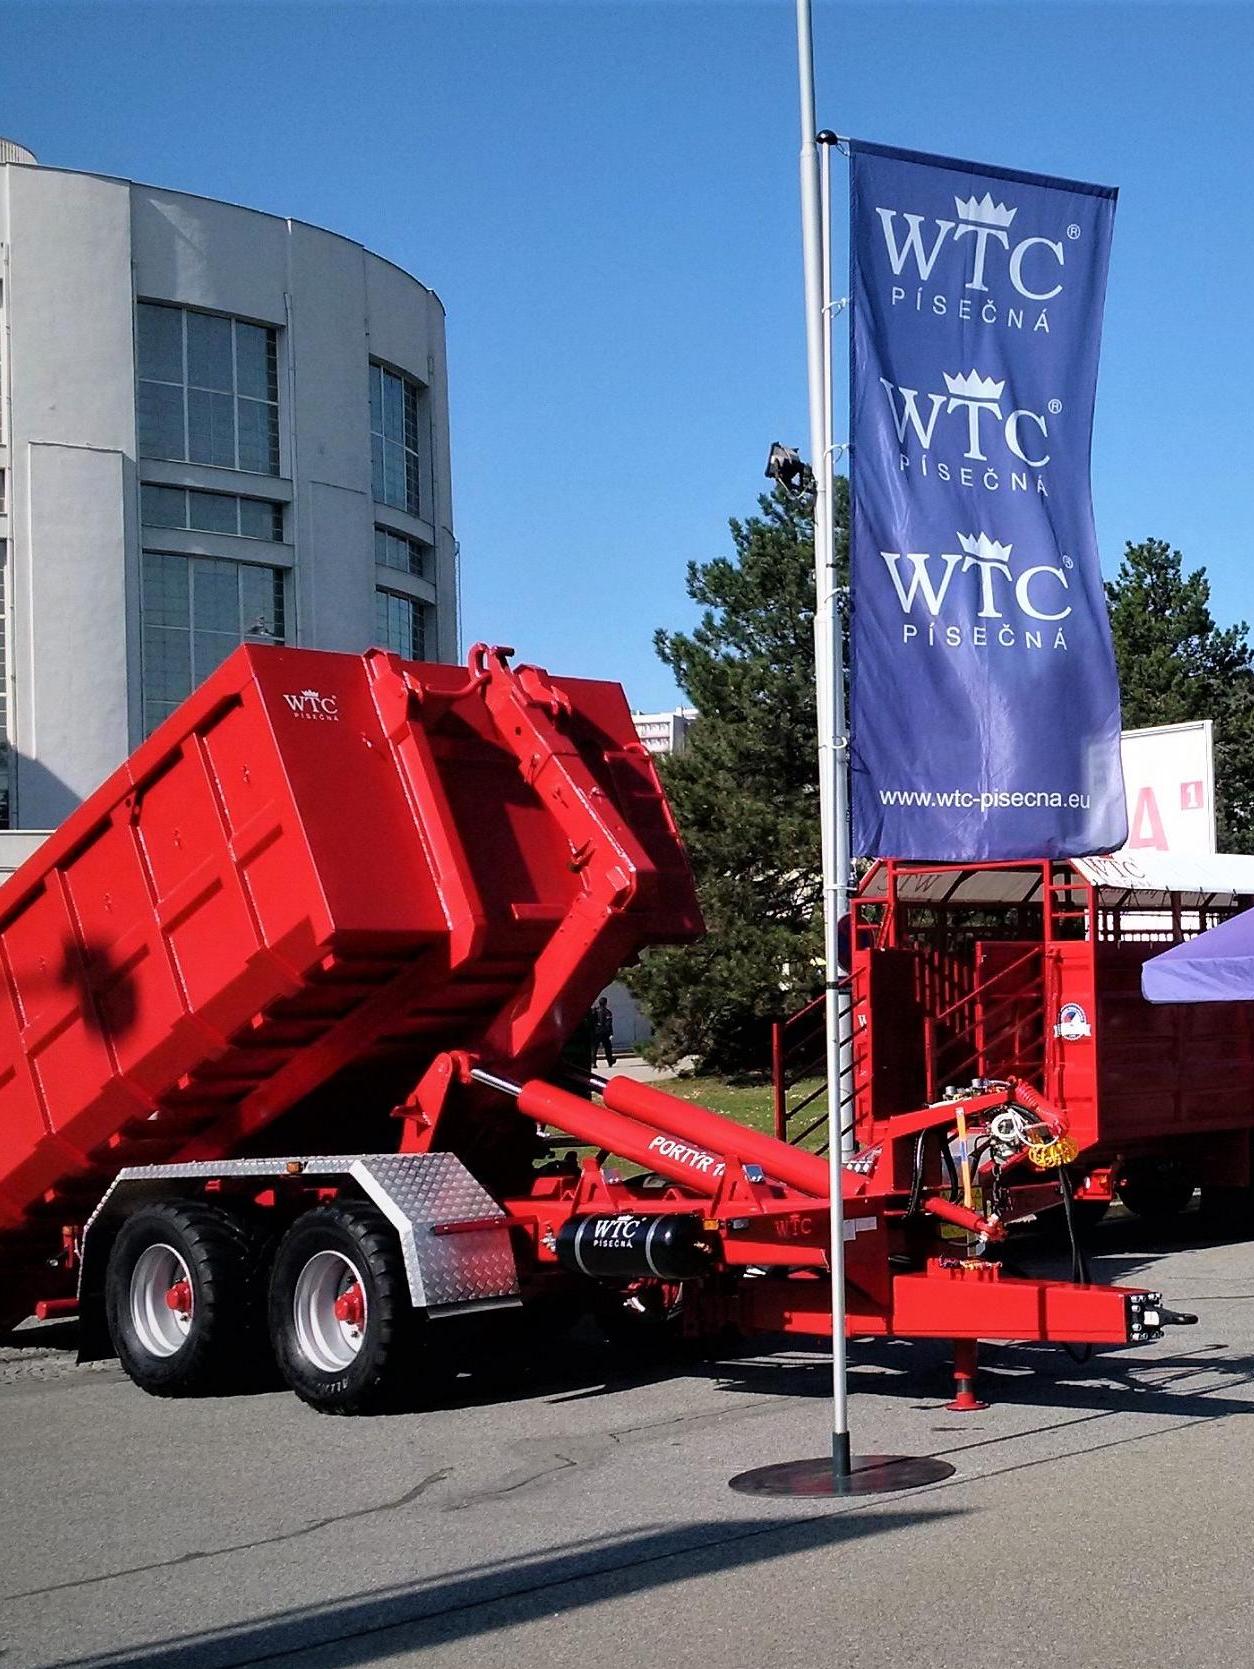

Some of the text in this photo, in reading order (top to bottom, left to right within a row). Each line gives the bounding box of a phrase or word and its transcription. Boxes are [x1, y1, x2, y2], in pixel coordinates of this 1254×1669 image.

[891, 286, 1050, 333] PÍSEČNÁ
[900, 454, 1048, 497] PÍSEČNÁ
[903, 624, 1068, 651] PÍSEČNÁ
[282, 694, 338, 715] WTC
[879, 788, 1091, 812] www.wtc-pisecna.eu
[648, 1135, 714, 1173] PORTÝR
[593, 1219, 641, 1238] WTC
